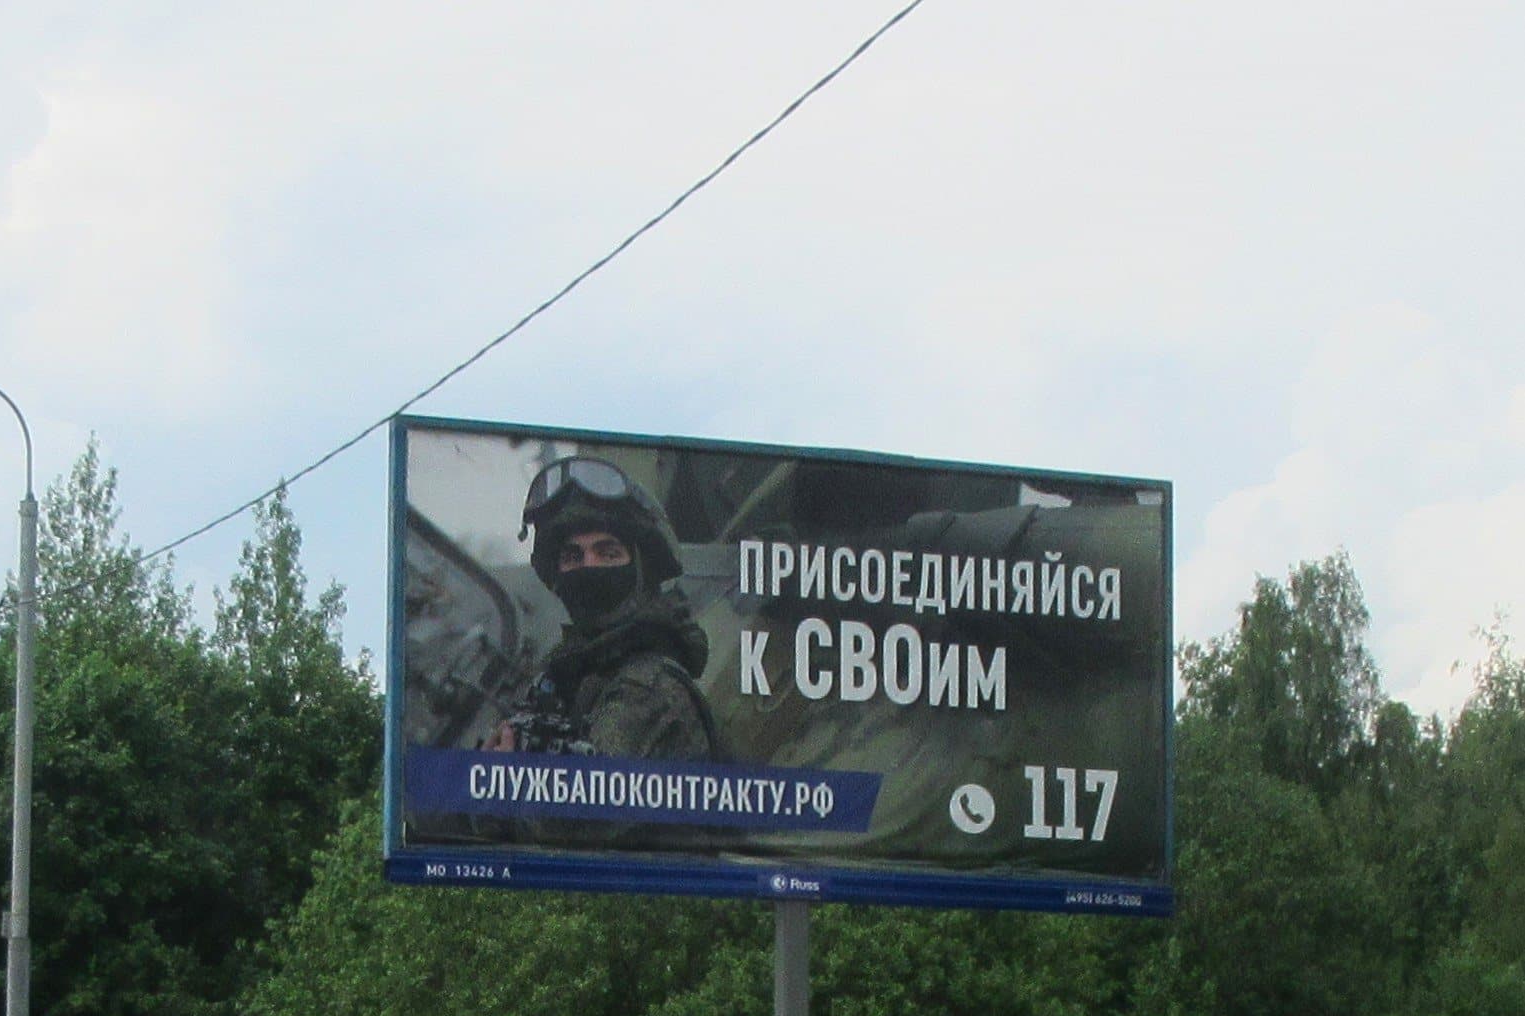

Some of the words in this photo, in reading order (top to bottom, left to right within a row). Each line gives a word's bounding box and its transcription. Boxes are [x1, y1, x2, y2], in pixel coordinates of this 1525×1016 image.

[739, 540, 1122, 620] ПРИСОЕДИНЯЙСЯ
[469, 764, 835, 818] СЛУЖБАПОКОНТРАКТУ.РФ
[1024, 765, 1119, 842] 117
[456, 865, 494, 878] 13426
[790, 879, 820, 891] Russ
